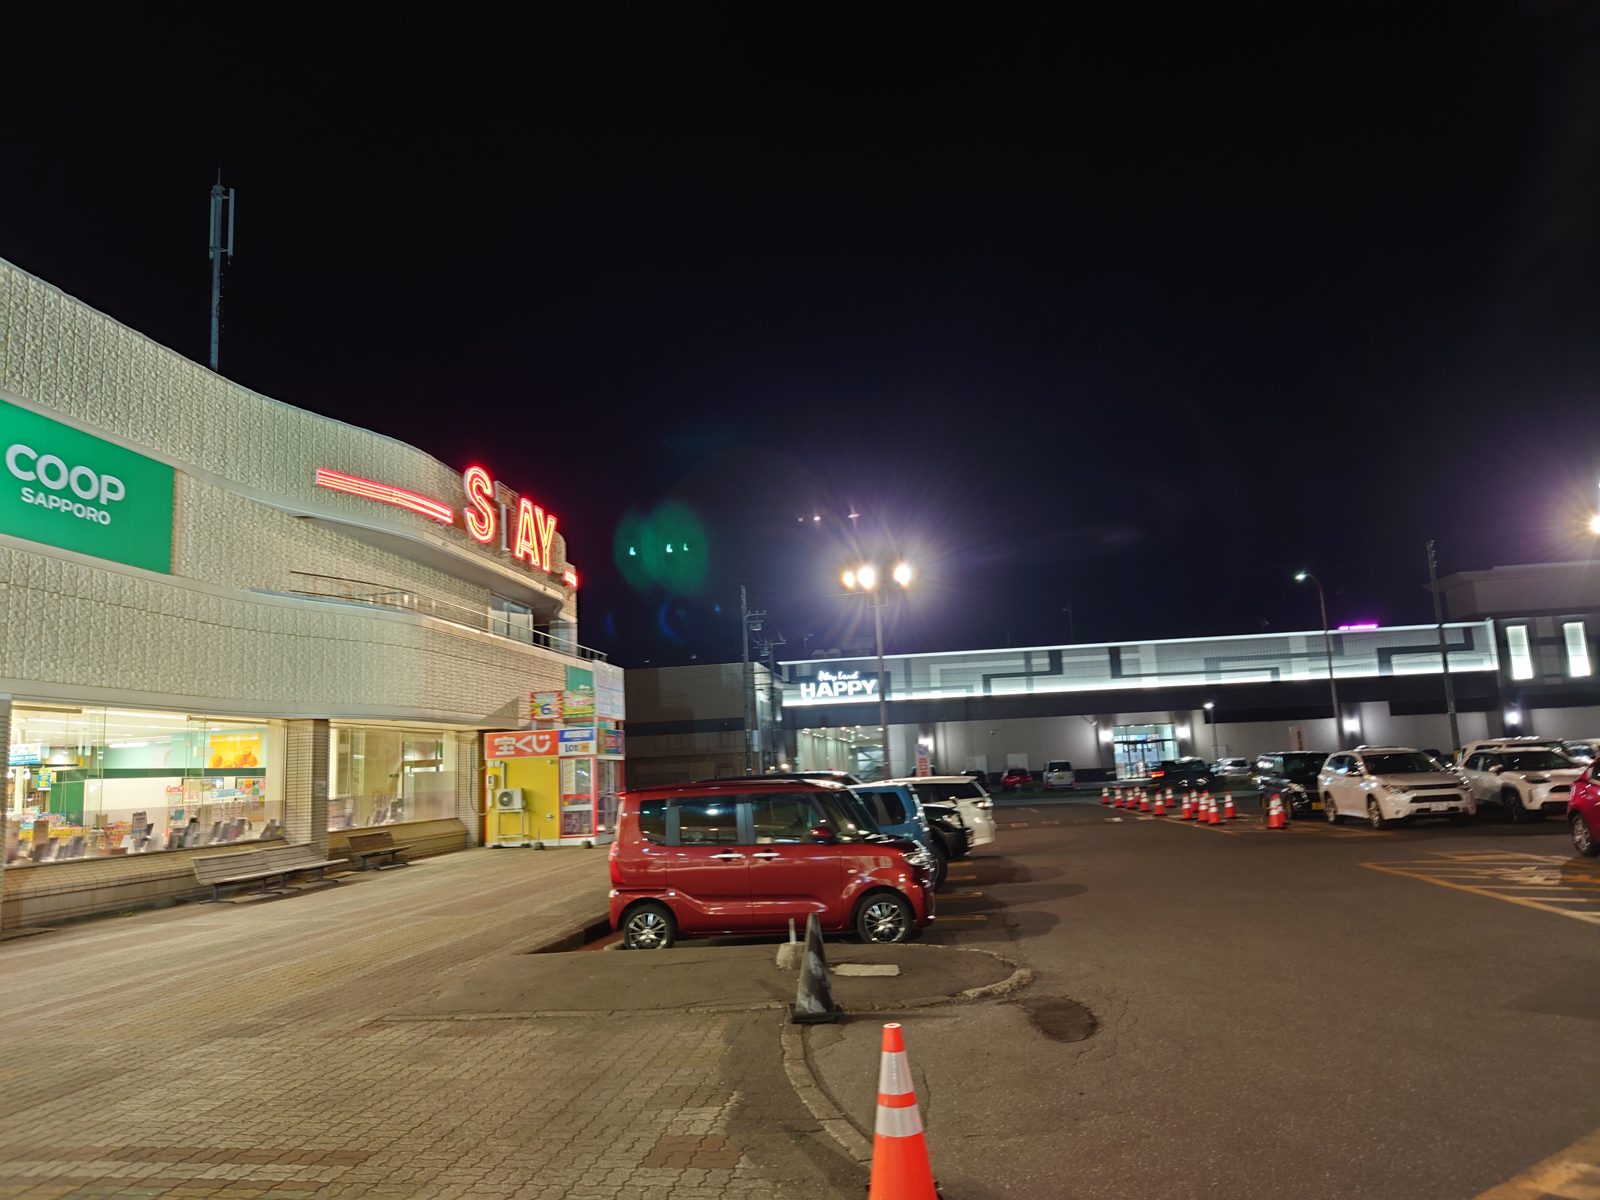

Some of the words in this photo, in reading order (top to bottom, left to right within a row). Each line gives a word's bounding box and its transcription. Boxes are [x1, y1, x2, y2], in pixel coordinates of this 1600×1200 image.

[5, 443, 126, 505] COOP
[20, 486, 112, 526] SAPPORO
[800, 679, 878, 699] HAPPY
[494, 734, 551, 756] 宝くじ
